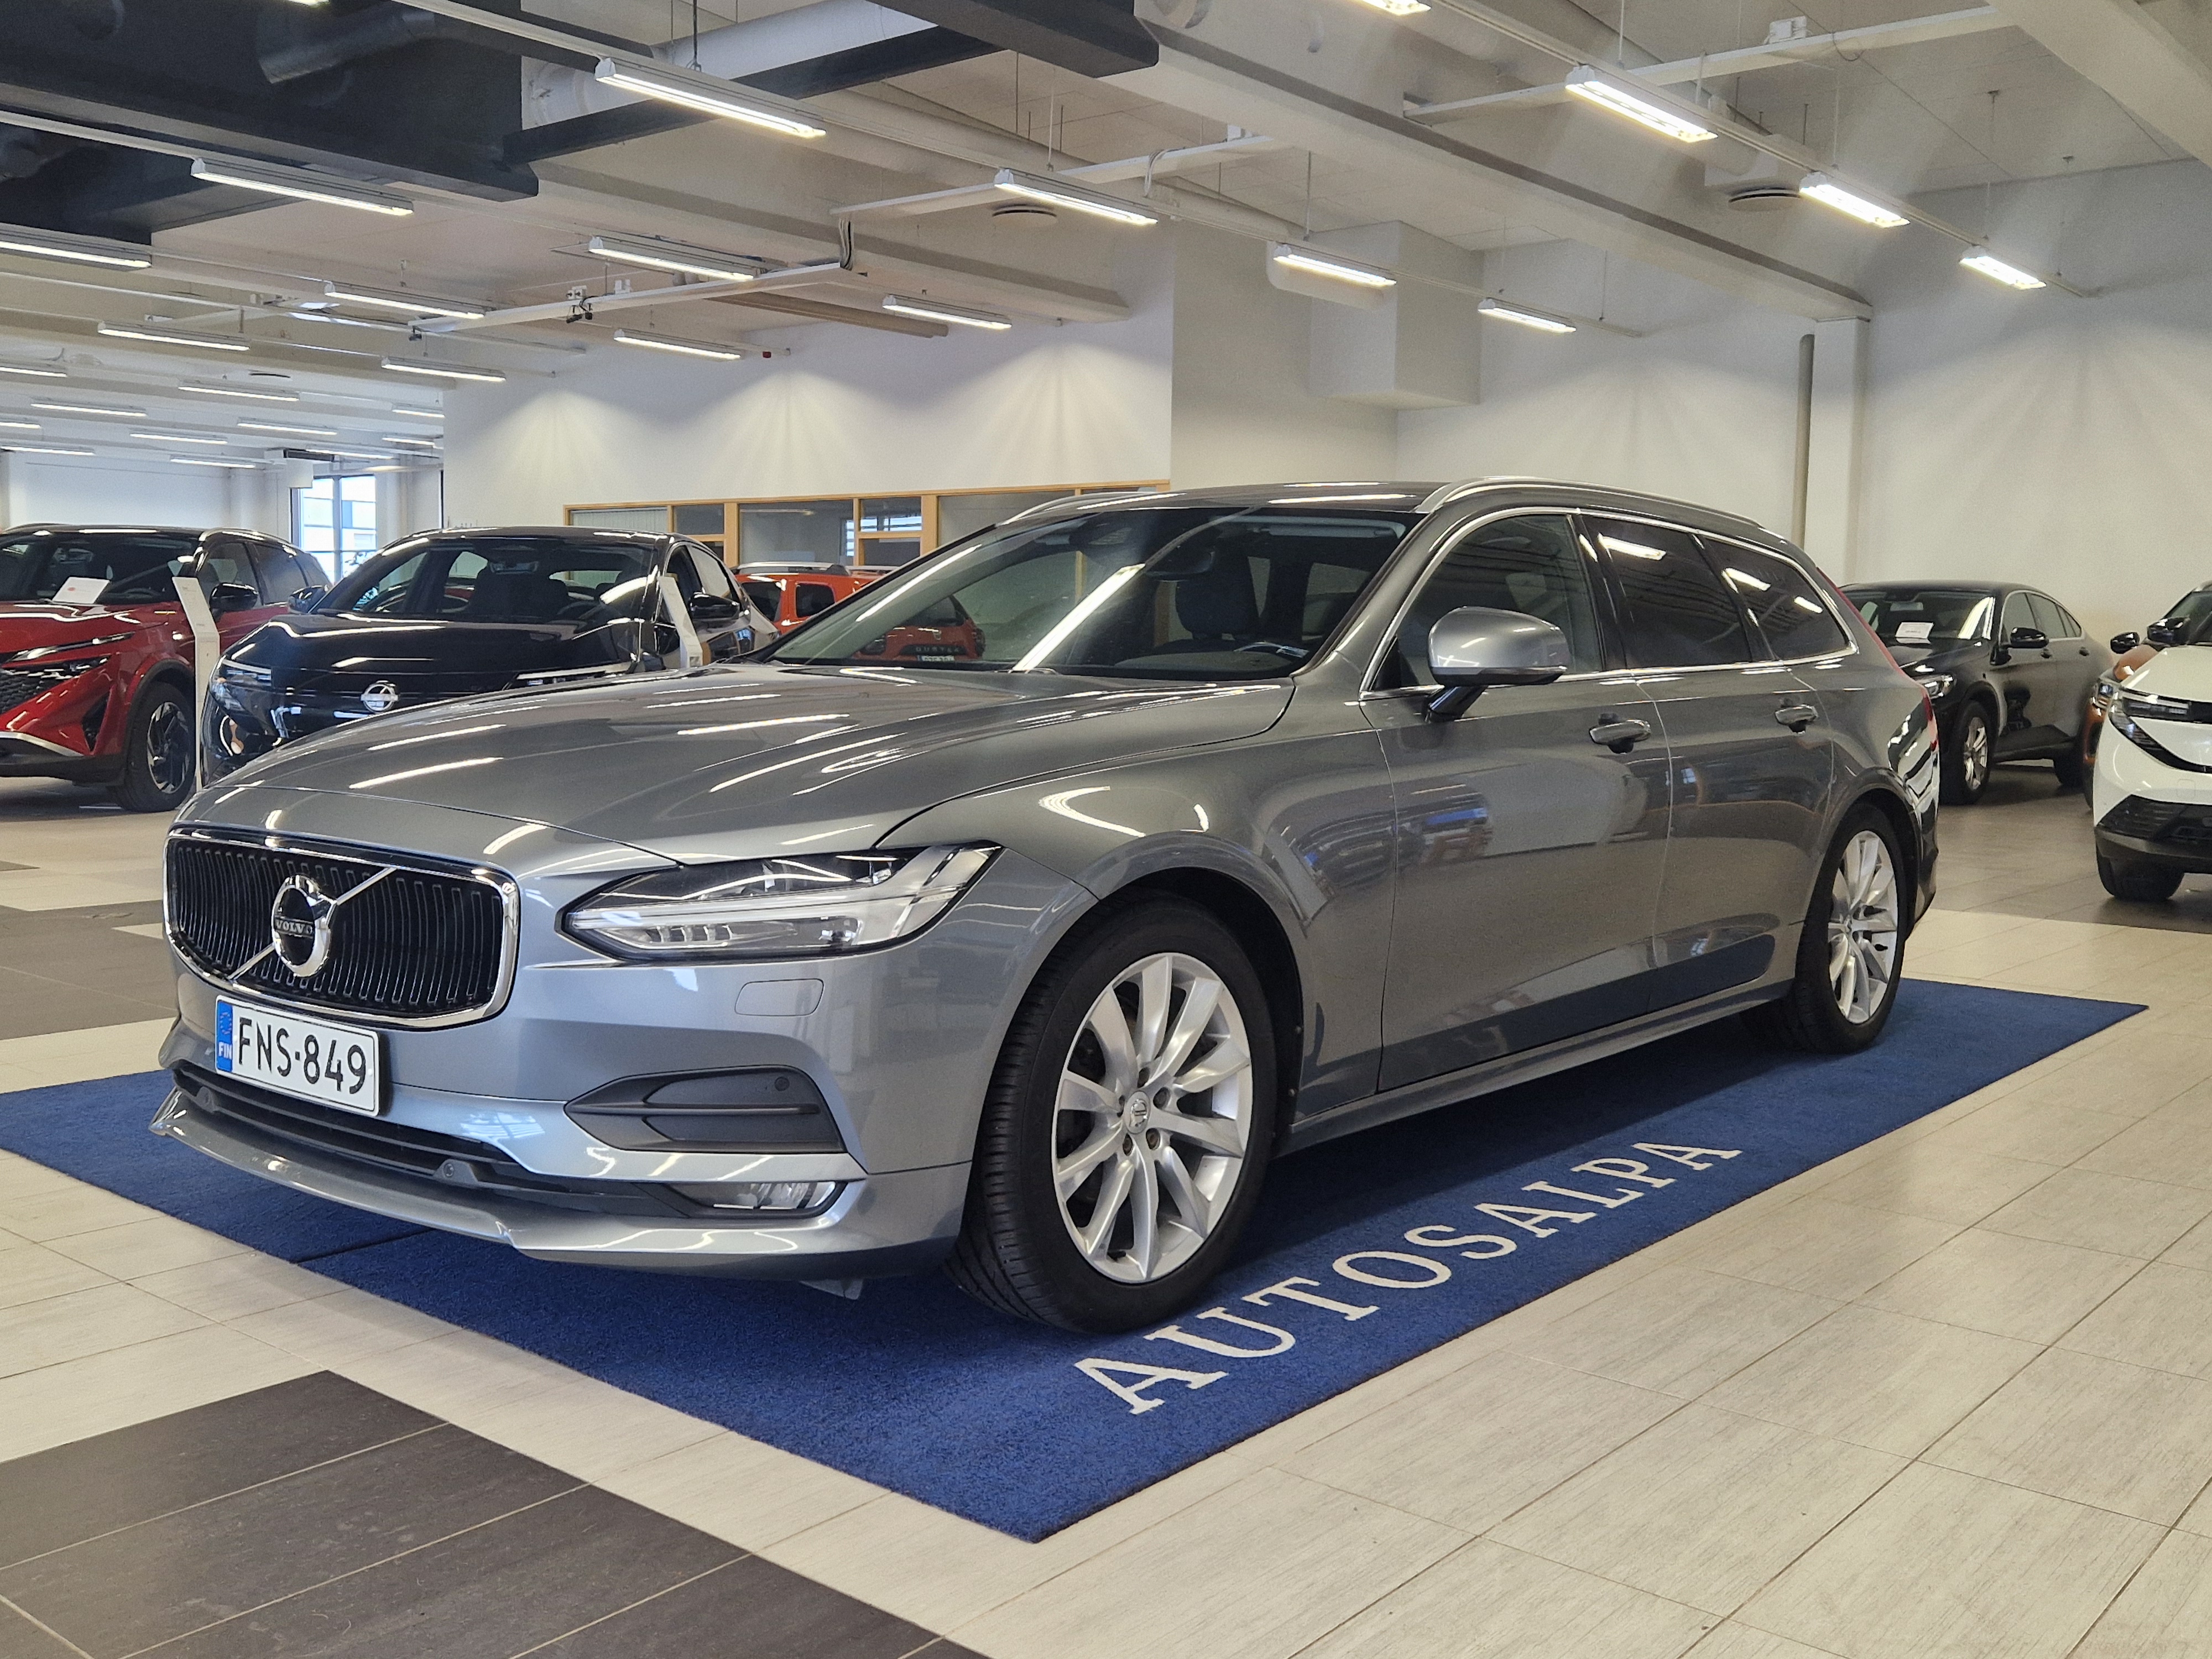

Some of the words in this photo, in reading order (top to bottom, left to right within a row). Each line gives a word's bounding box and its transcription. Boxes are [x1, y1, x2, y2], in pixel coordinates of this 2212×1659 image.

[276, 919, 313, 935] VOLVO
[218, 1041, 232, 1060] FIN
[239, 1017, 366, 1095] FNS-849
[1074, 1142, 1743, 1415] AUTOSALPA
